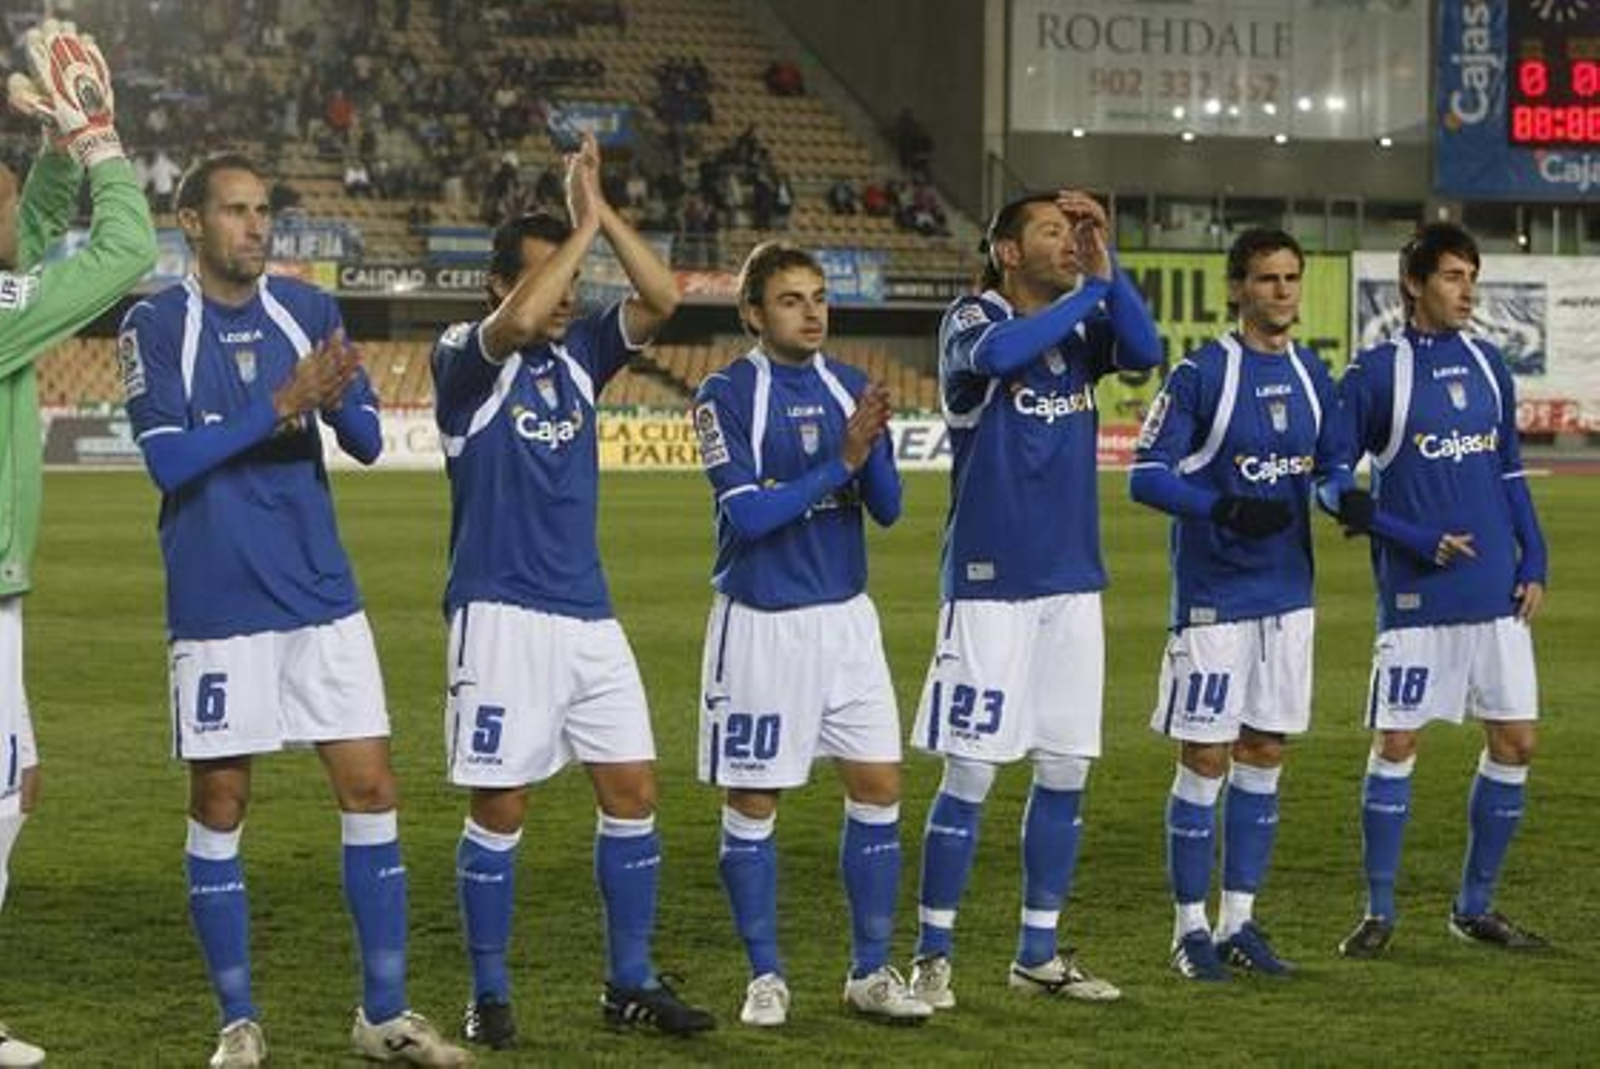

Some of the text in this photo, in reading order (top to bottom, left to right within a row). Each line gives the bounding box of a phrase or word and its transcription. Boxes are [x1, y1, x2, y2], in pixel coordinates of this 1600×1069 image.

[1037, 12, 1294, 59] ROCHDALE
[341, 267, 426, 287] CALIDAD
[196, 672, 228, 723] 6
[948, 684, 1005, 734] 23
[1185, 673, 1230, 715] 14
[1388, 667, 1428, 705] 18
[472, 705, 506, 754] 5
[725, 713, 781, 760] 20
